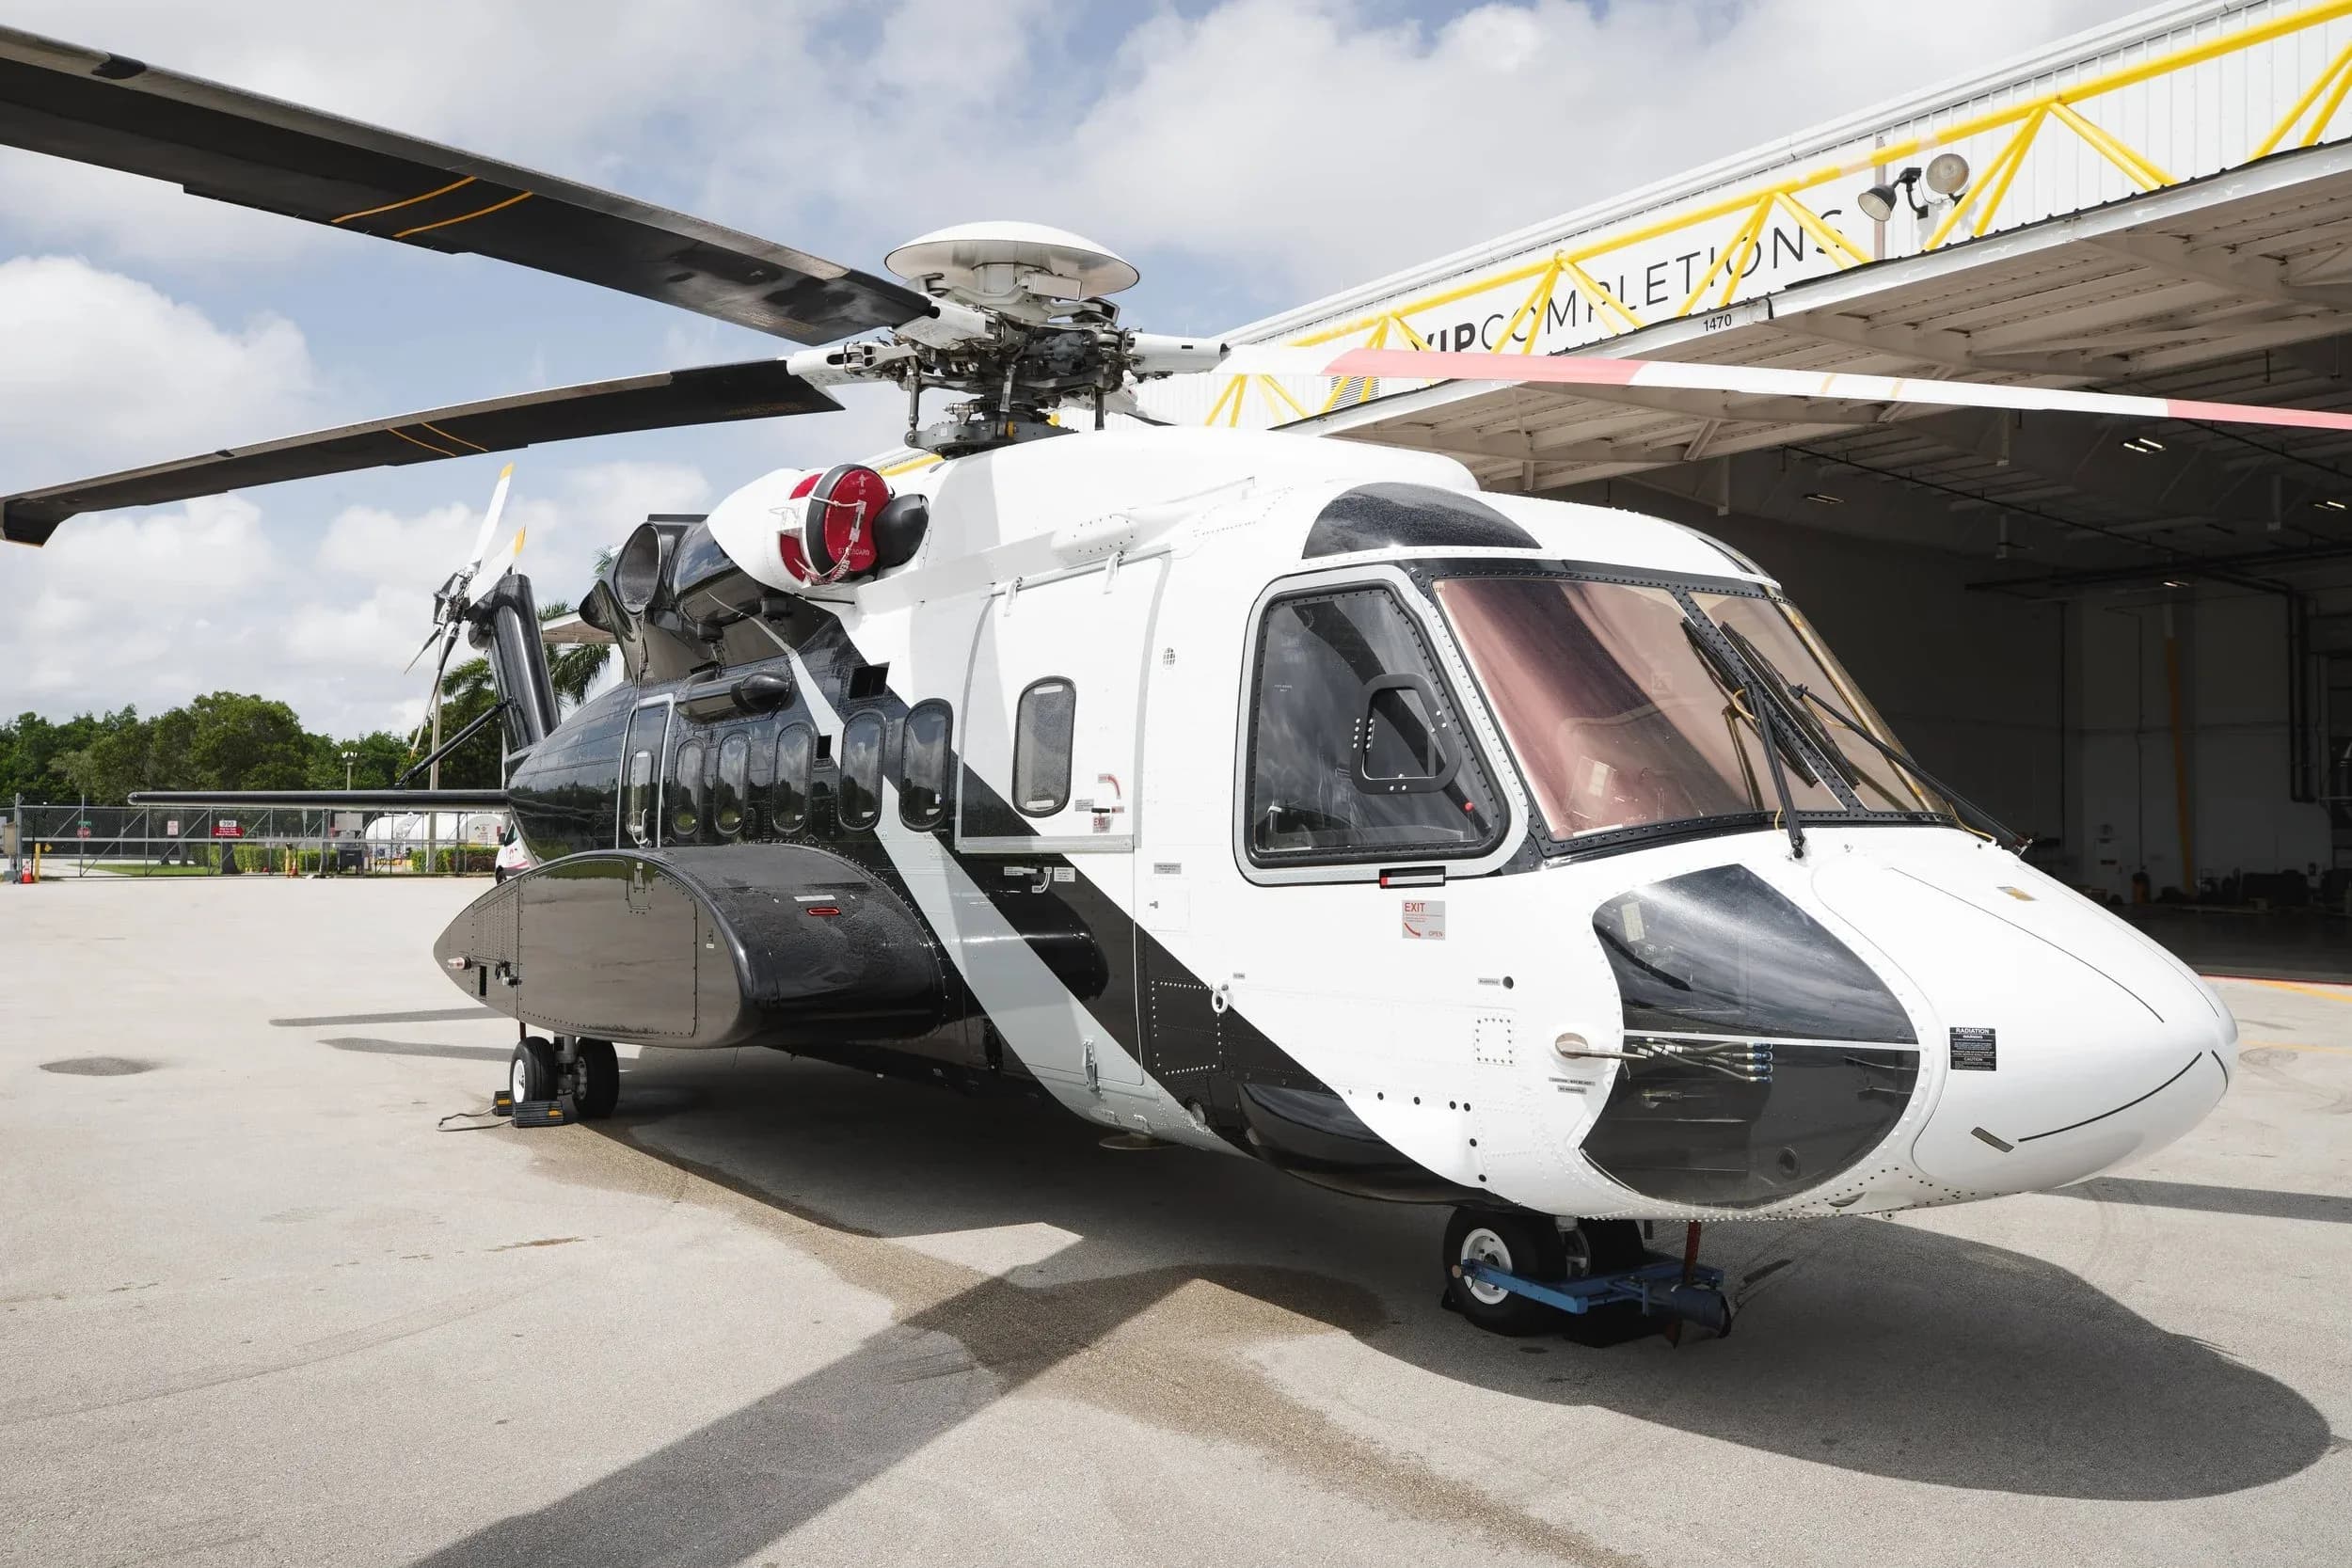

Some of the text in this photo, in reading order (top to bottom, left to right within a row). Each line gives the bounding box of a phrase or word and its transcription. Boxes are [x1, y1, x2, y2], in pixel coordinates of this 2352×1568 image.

[1703, 313, 1732, 332] 1470
[837, 547, 870, 557] STBOARD
[1405, 902, 1426, 912] EXIT
